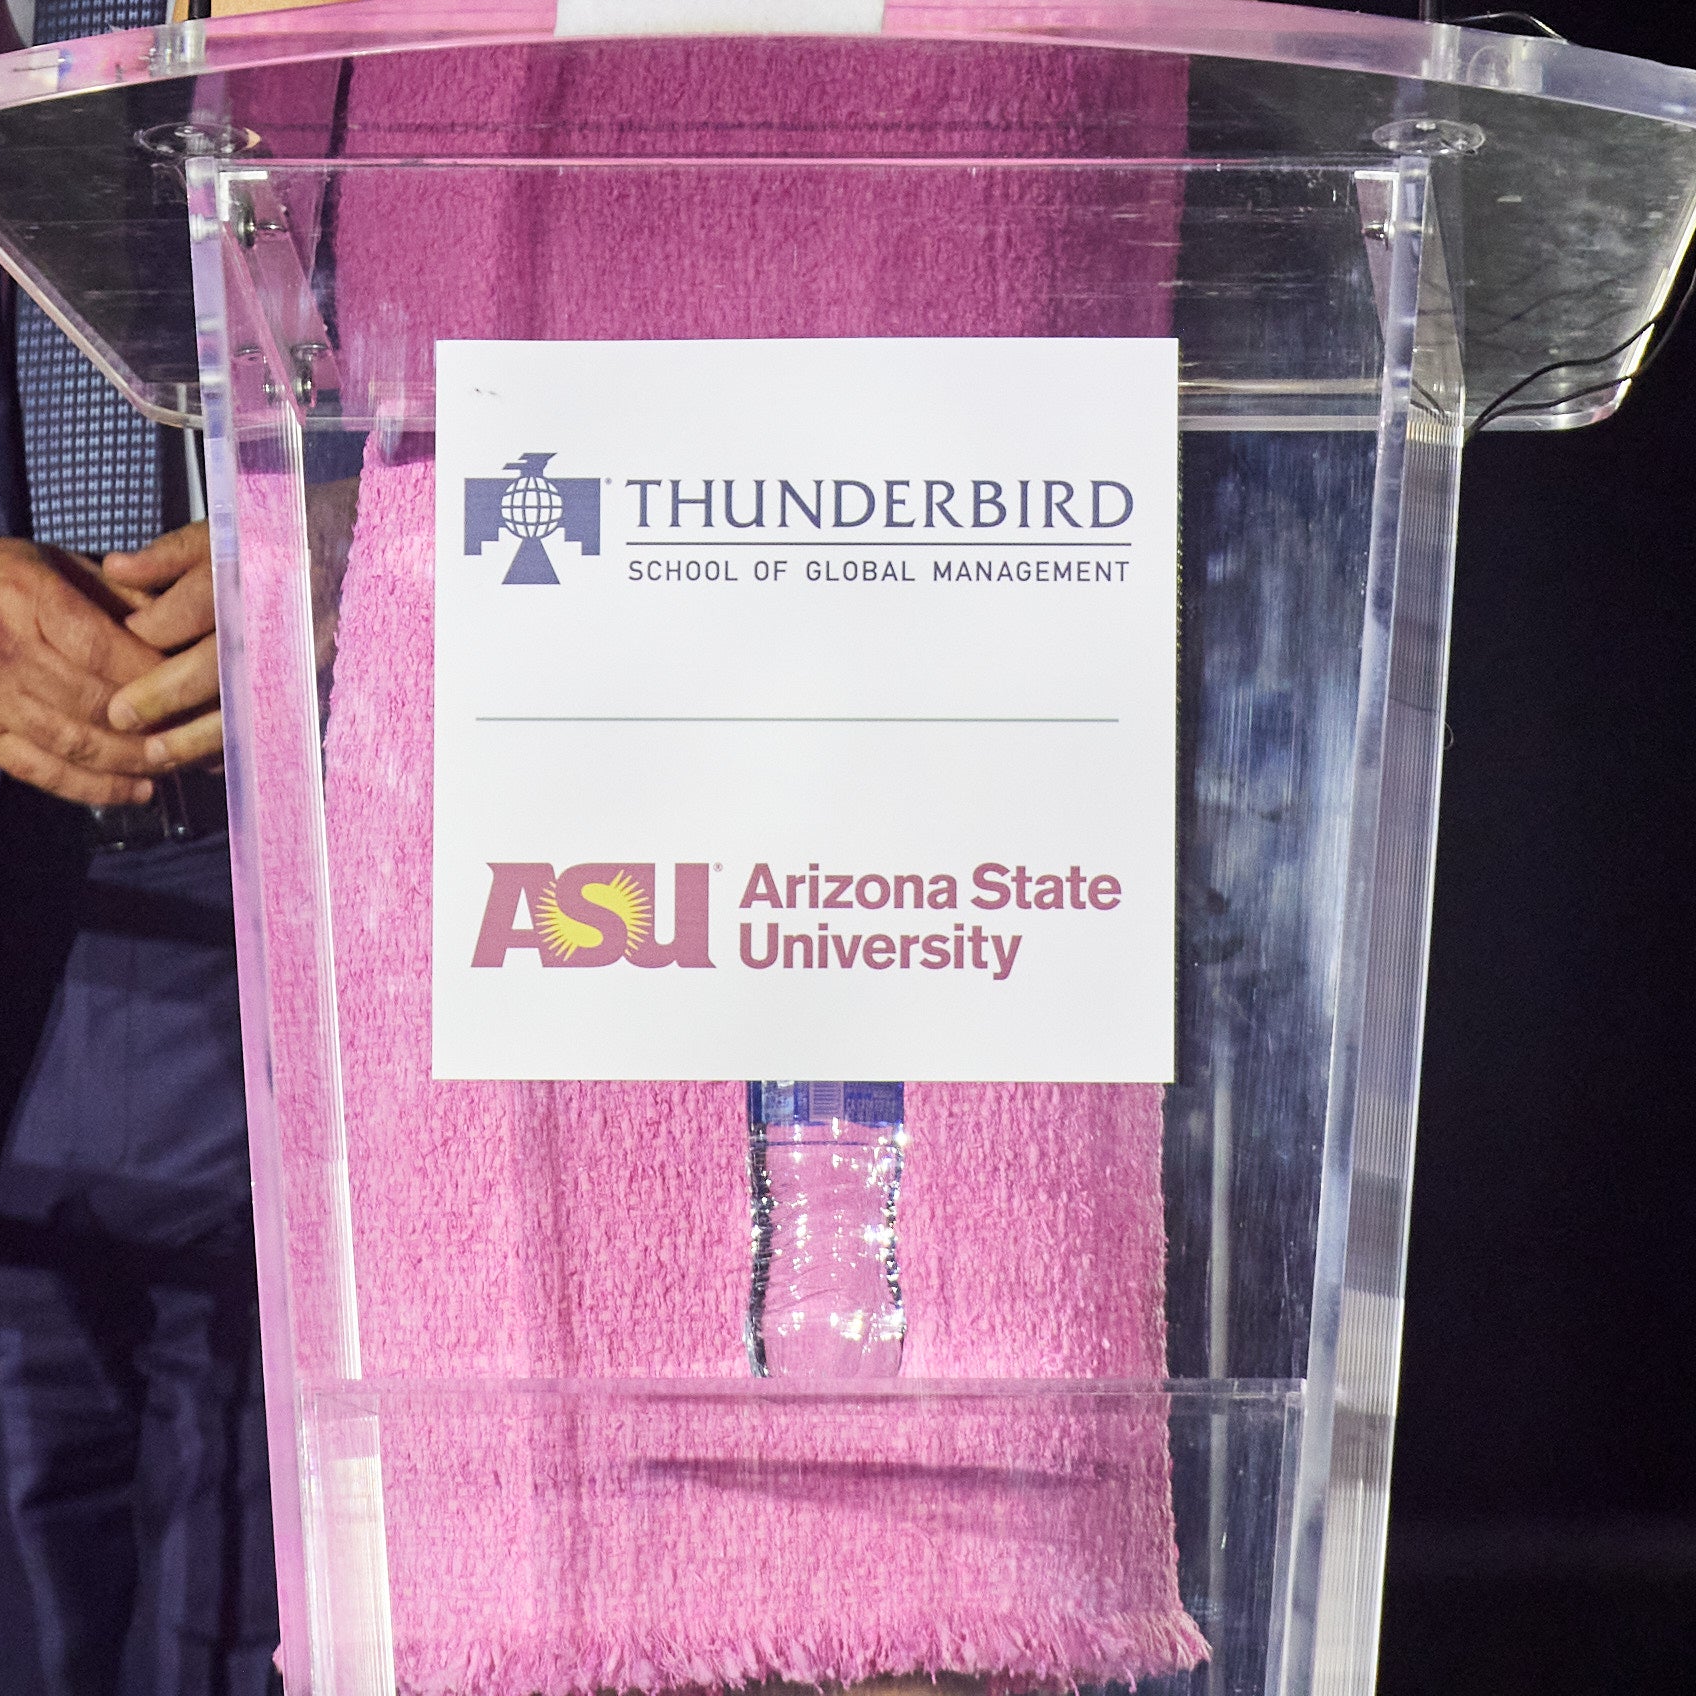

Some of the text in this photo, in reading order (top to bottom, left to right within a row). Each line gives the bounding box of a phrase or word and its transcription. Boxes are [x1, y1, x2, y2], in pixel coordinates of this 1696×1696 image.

[625, 479, 1134, 530] THUNDERBIRD
[628, 560, 1130, 582] SCHOOL OF GLOBAL MANAGEMENT
[738, 862, 1122, 911] Arizona State
[470, 862, 717, 968] ASU
[739, 922, 1023, 981] University
